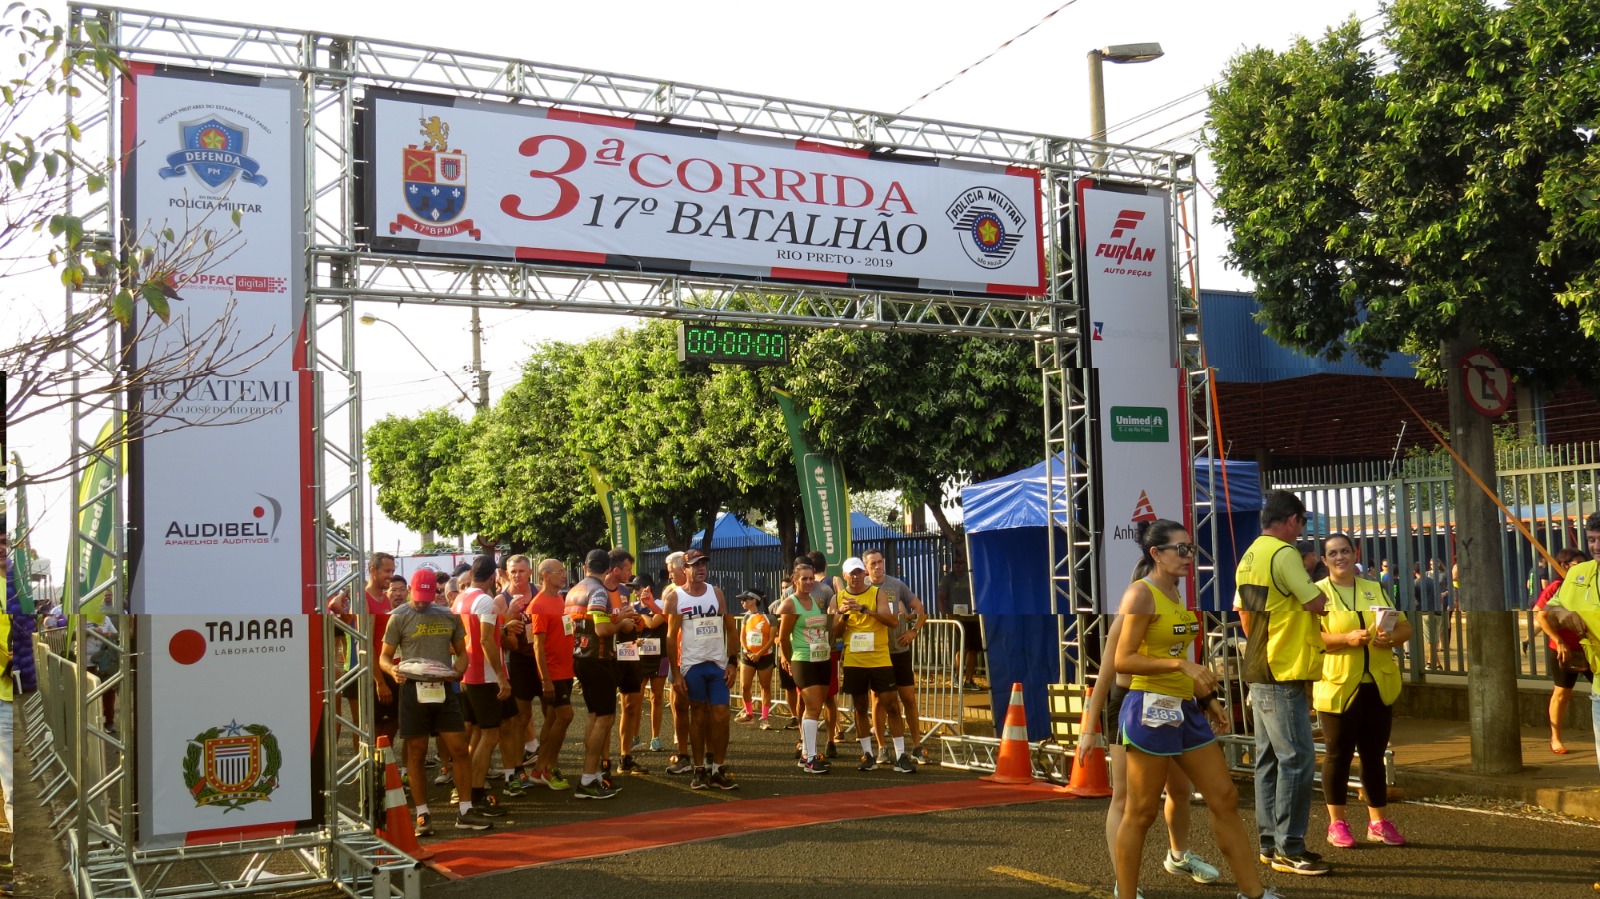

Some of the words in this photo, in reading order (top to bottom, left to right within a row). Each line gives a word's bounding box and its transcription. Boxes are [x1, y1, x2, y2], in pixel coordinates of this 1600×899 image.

[179, 104, 205, 113] MILITARES
[216, 105, 236, 113] ESTADO
[245, 113, 256, 122] SÃO
[256, 120, 271, 134] PAULO
[185, 151, 241, 165] DEFENDA
[207, 167, 220, 175] PM
[628, 153, 918, 214] CORRIDA
[169, 198, 214, 210] POLÍCIA
[218, 202, 262, 213] MILITAR
[987, 191, 1021, 226] MILITAR
[666, 201, 927, 254] BATALHÃO
[776, 250, 802, 261] RIO
[806, 252, 854, 264] PRETO
[865, 257, 893, 268] 2019
[1095, 237, 1156, 265] FURLAN
[1104, 267, 1126, 275] AUTO
[1127, 268, 1152, 278] PEÇAS
[179, 273, 234, 286] COPFAC
[238, 278, 267, 290] digital
[687, 329, 784, 357] 00:00:00
[150, 378, 293, 402] IGUATEMI
[185, 404, 211, 414] JOSÉ
[213, 406, 228, 414] DO
[229, 406, 248, 414] RIO
[250, 407, 283, 415] PRETO
[1115, 415, 1150, 425] Unimed
[165, 521, 268, 538] AUDIBEL
[817, 489, 834, 554] Unimed
[205, 618, 293, 642] TAJARA
[698, 626, 715, 635] 309
[215, 645, 286, 656] LABORATÓRIO
[1151, 708, 1178, 721] 385
